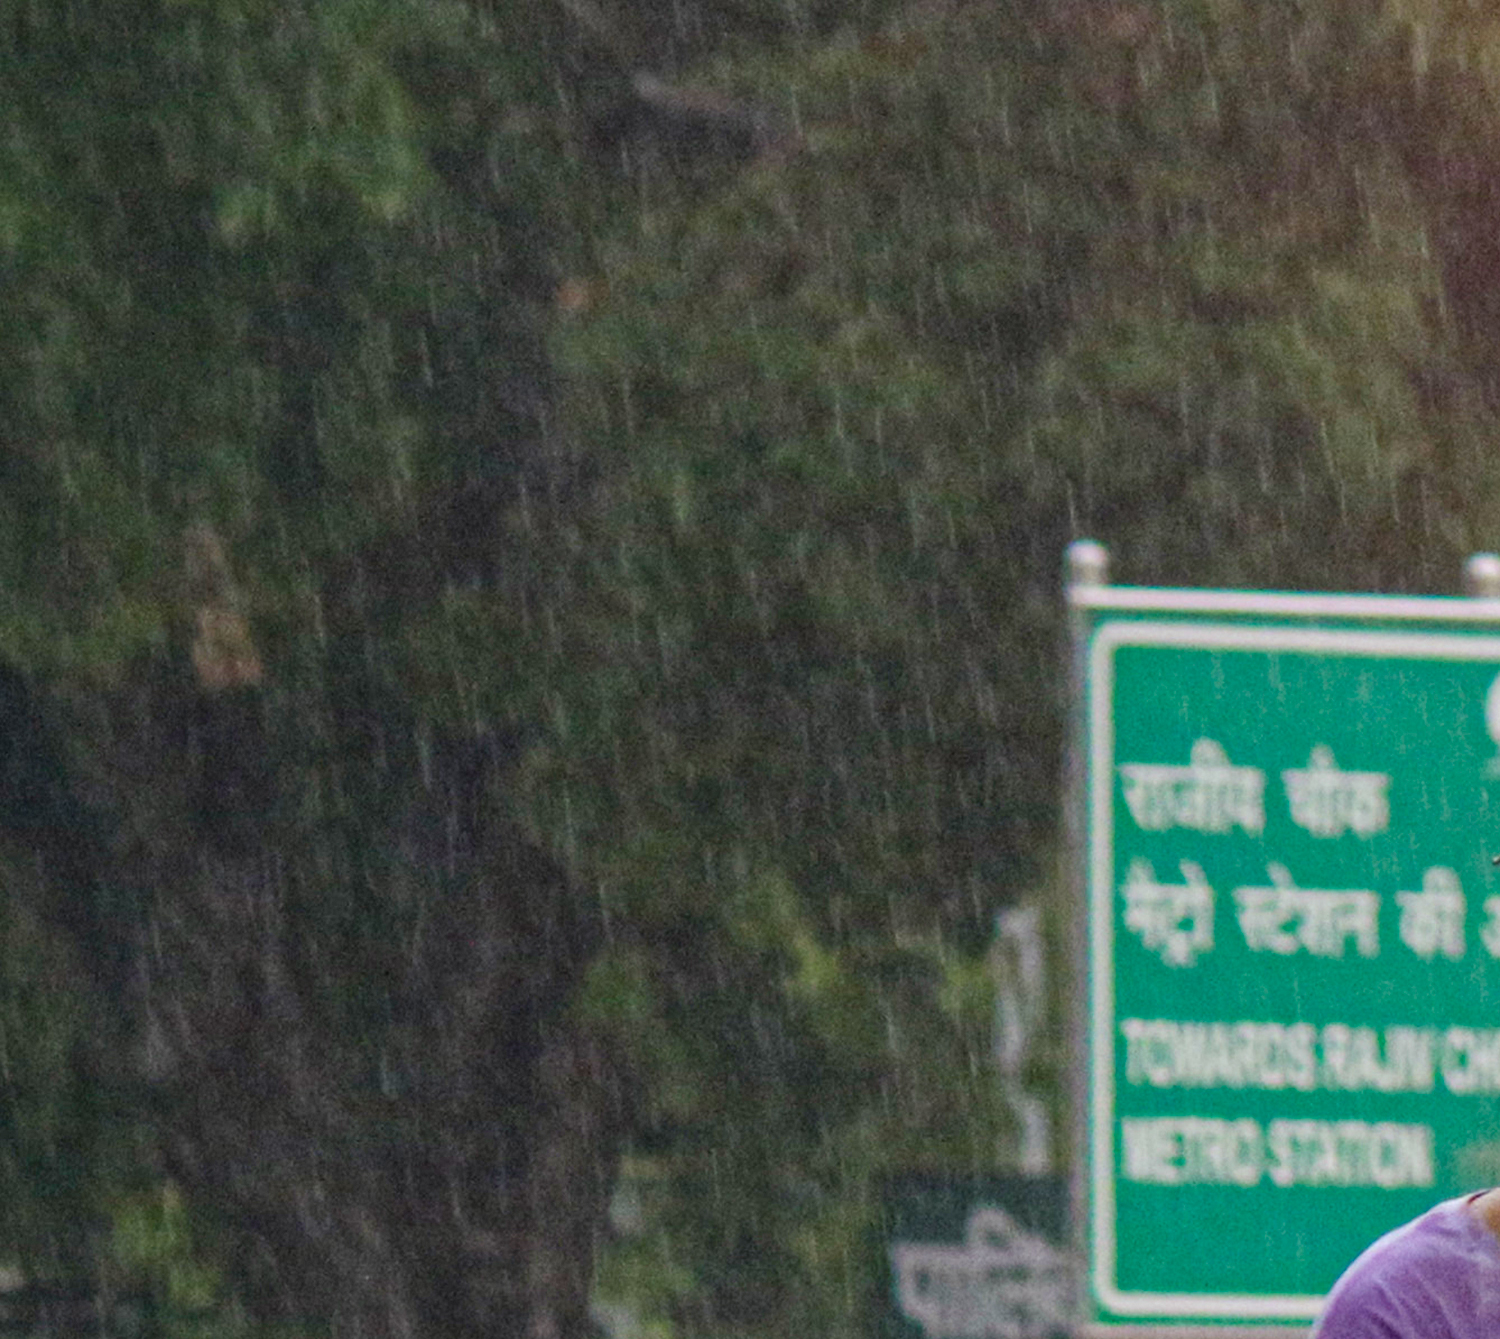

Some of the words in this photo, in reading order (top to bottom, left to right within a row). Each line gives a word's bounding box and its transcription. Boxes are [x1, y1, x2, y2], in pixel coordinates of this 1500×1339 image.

[1118, 737, 1265, 834] राजीव
[1231, 860, 1381, 958] स्टेशन
[1395, 866, 1466, 961] की
[1121, 1018, 1317, 1091] TOWARDS
[1321, 1023, 1435, 1093] RAJIV
[1121, 1115, 1263, 1187] METRO
[1266, 1117, 1436, 1188] STATION
